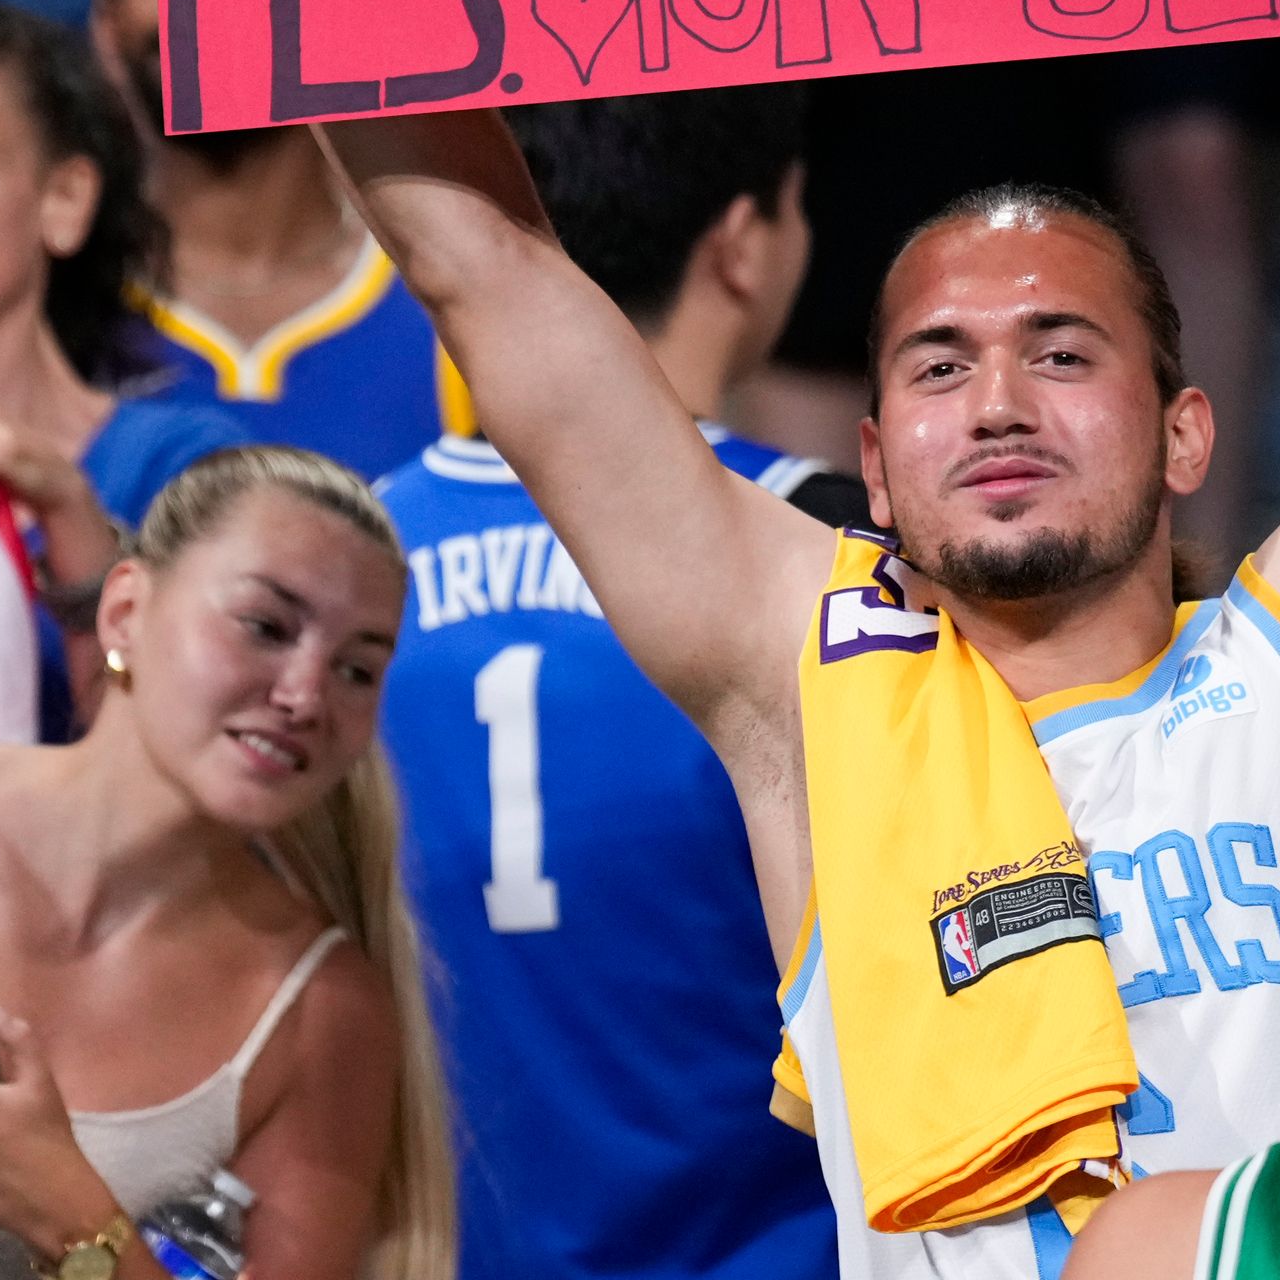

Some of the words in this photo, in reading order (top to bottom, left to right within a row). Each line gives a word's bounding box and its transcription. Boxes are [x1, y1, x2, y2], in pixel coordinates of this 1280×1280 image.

[408, 522, 607, 632] IRVIN
[1162, 682, 1247, 739] bibigo
[474, 642, 559, 934] 1
[931, 883, 968, 915] LORE
[966, 861, 1021, 894] SERIES
[994, 881, 1061, 902] ENGINEERED
[975, 909, 990, 926] 48
